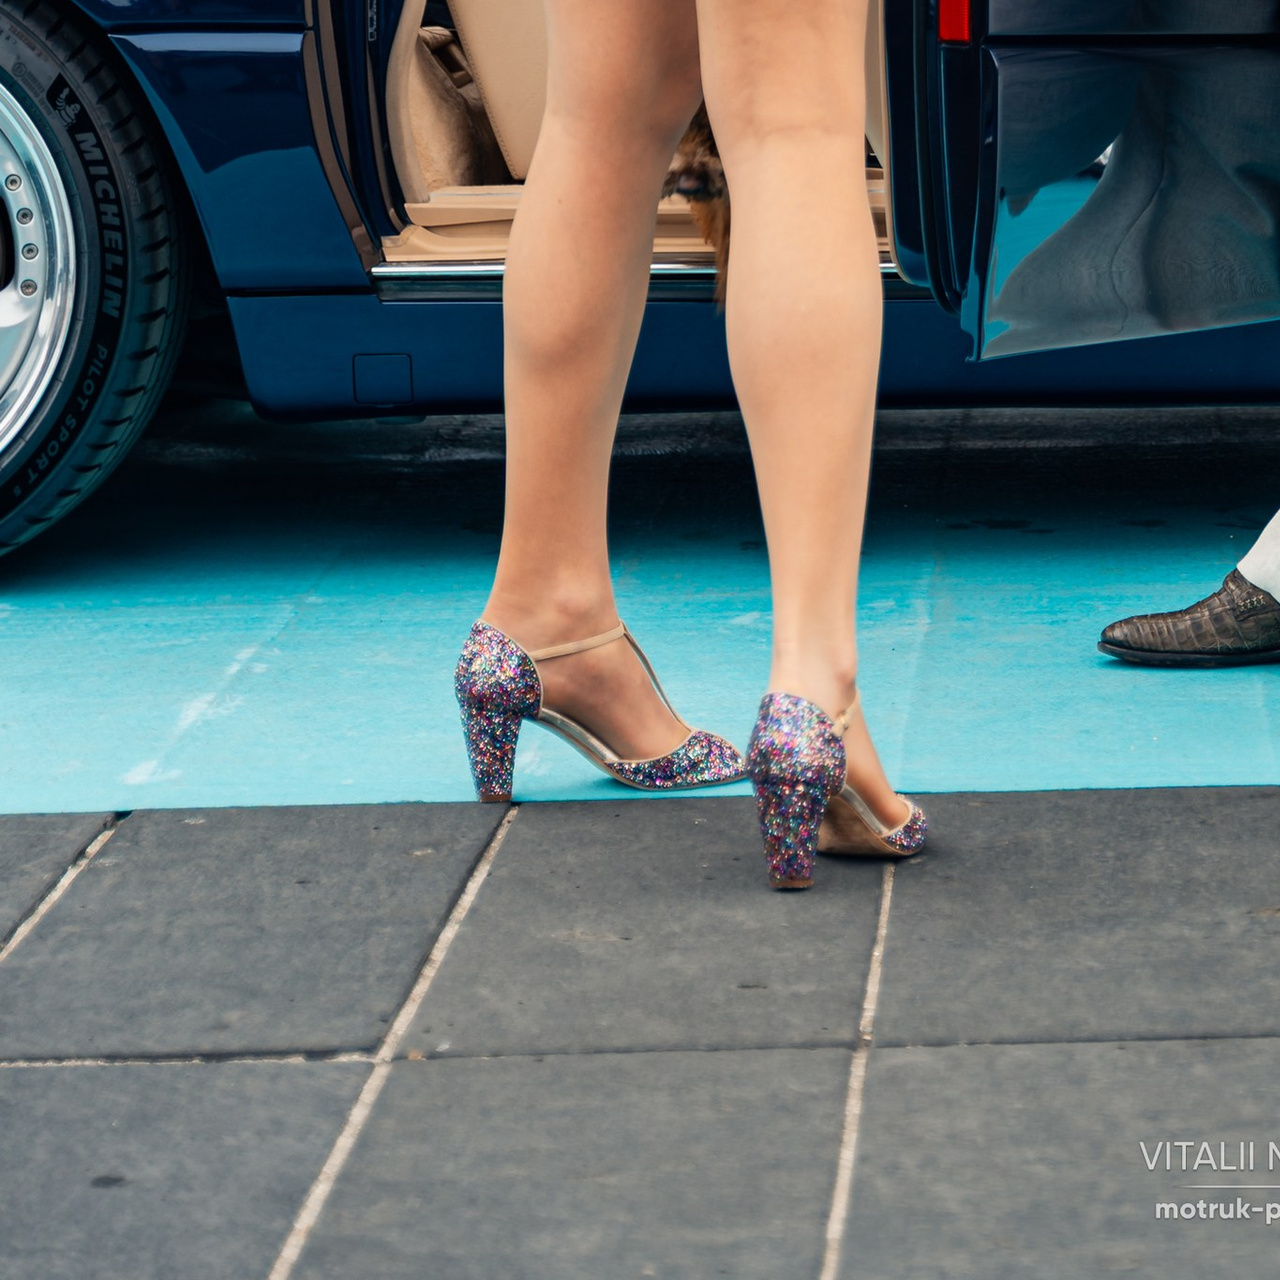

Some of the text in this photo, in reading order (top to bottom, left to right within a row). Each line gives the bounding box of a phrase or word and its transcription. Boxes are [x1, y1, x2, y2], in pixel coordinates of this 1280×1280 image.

[74, 131, 123, 319] MICHELIN
[75, 342, 109, 411] PILOT
[27, 413, 77, 483] SPORT
